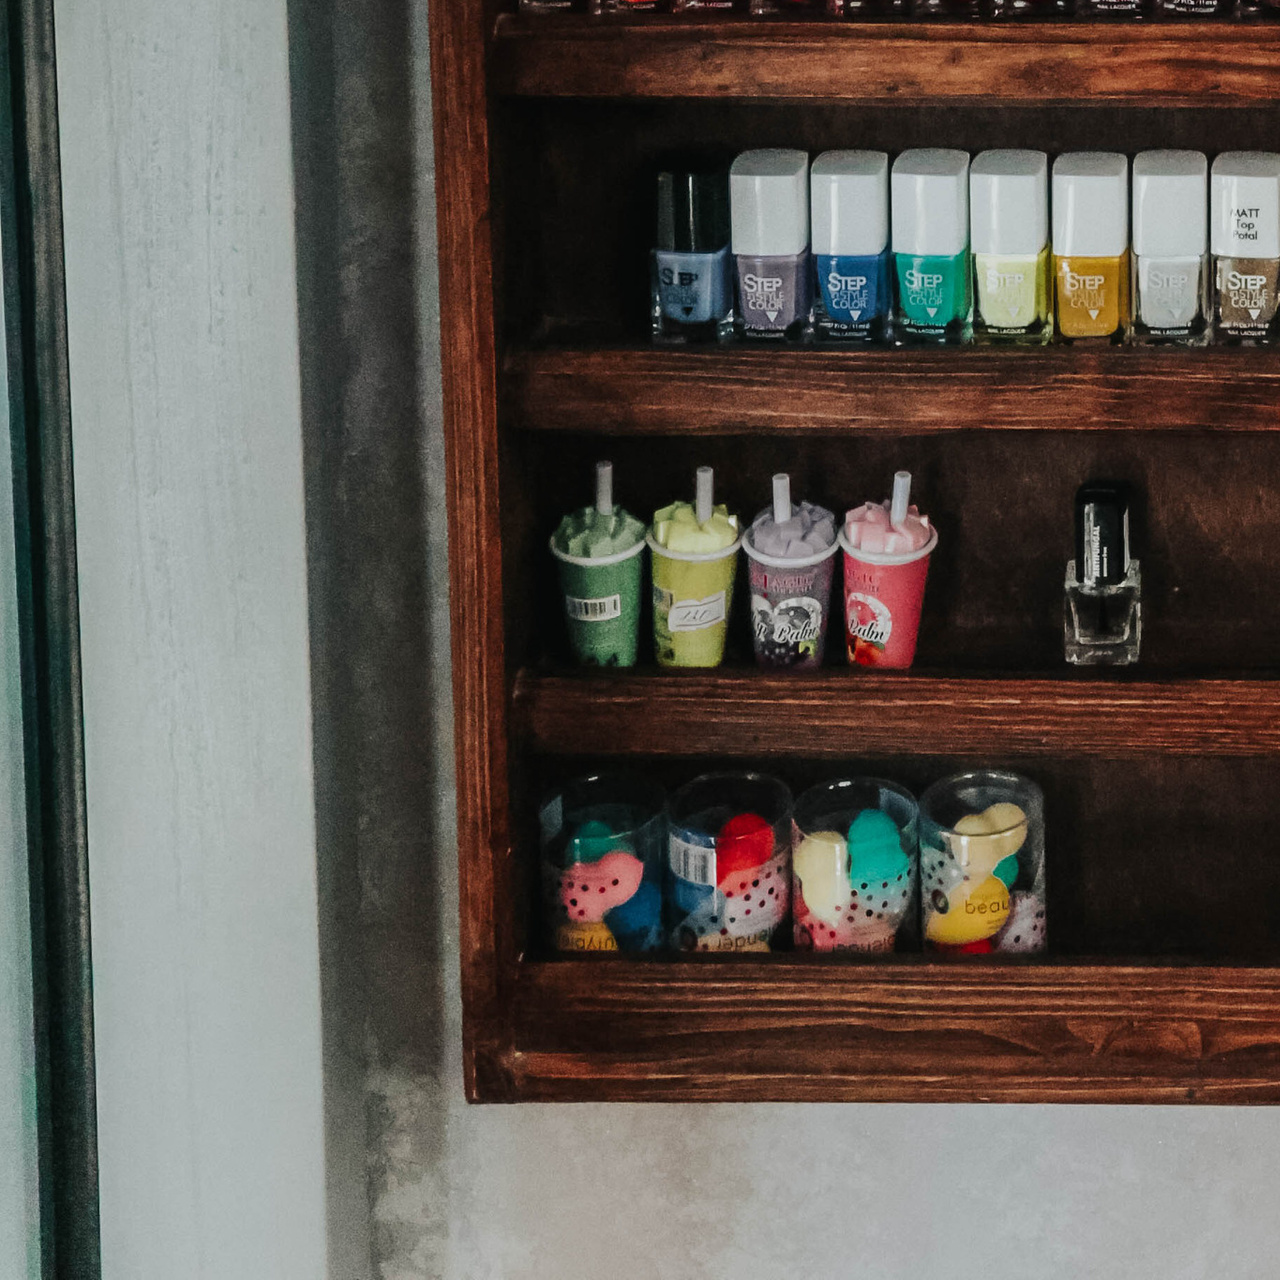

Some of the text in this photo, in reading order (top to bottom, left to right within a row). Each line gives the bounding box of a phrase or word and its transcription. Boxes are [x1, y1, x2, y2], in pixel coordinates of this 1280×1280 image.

[744, 274, 782, 293] STEP
[827, 272, 867, 291] STEP
[905, 270, 943, 289] STEP
[1066, 272, 1104, 290] STEP
[1228, 271, 1266, 290] STEP
[832, 298, 867, 309] COLOR
[1232, 298, 1266, 308] COLOR
